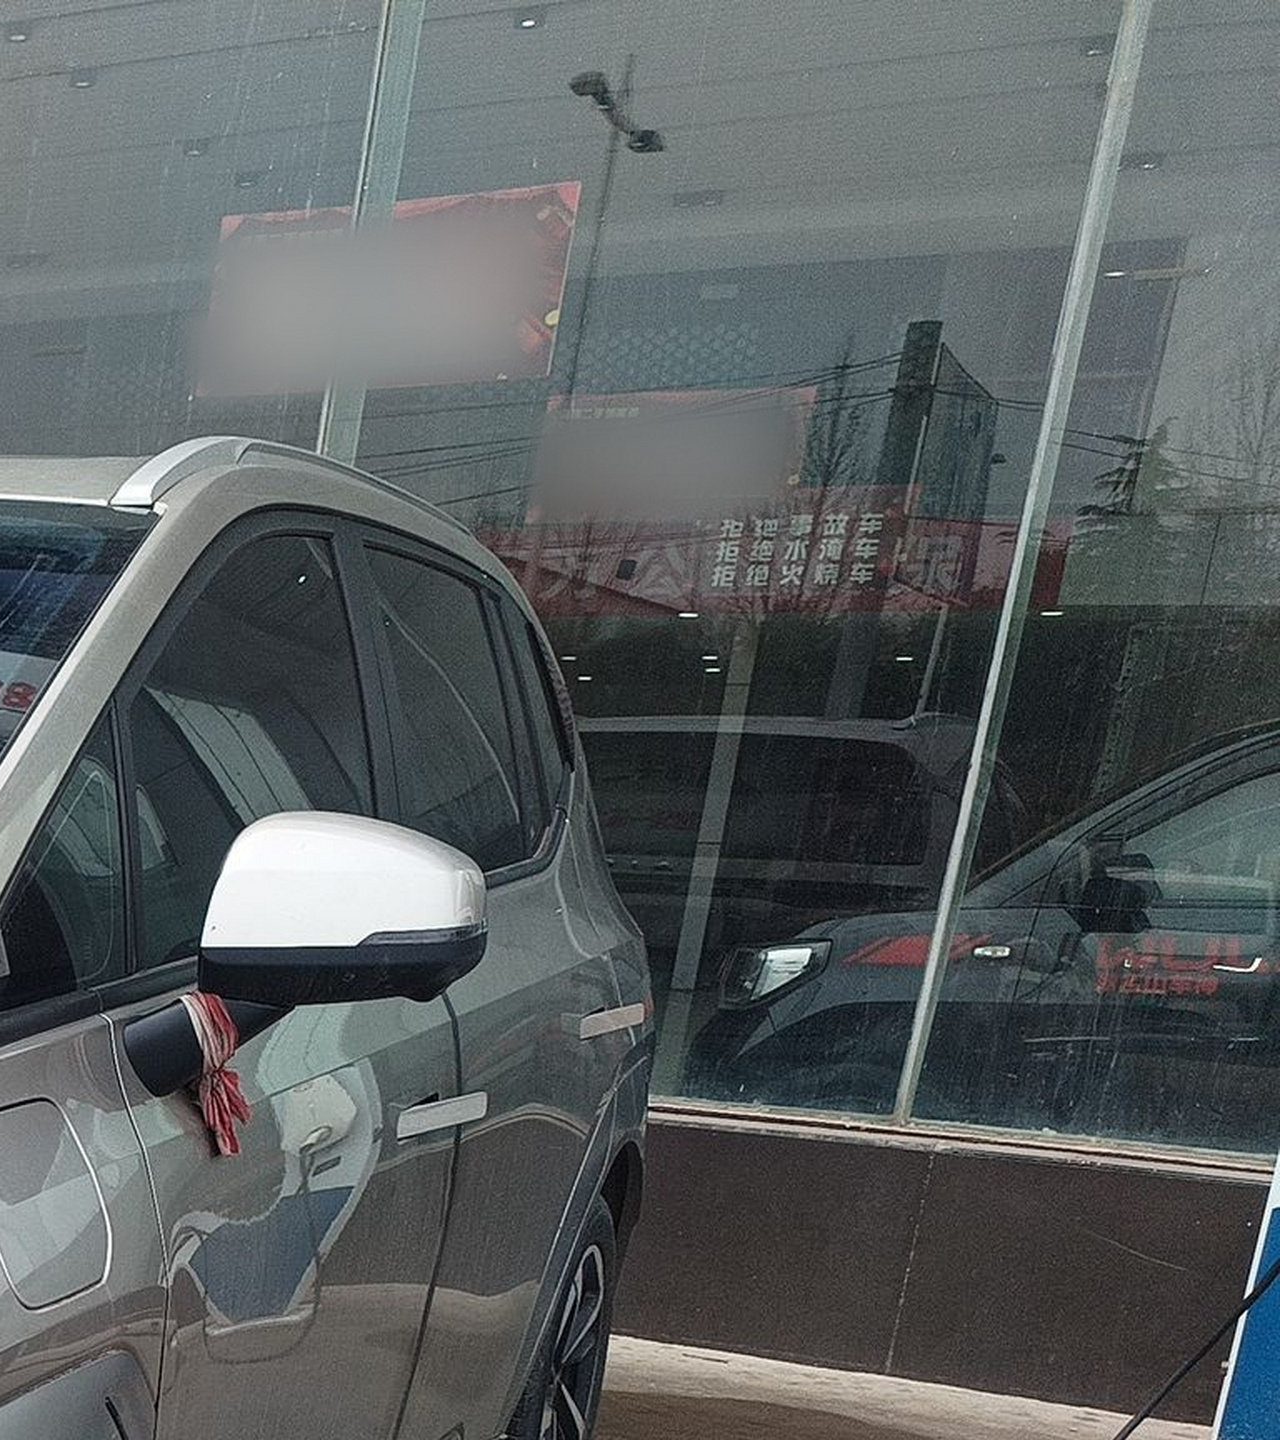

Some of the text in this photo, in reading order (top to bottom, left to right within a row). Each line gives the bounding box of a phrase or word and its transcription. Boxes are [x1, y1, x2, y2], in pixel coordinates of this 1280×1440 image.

[715, 539, 880, 563] 拒绝水淹车
[711, 564, 875, 588] 拒绝火烧车
